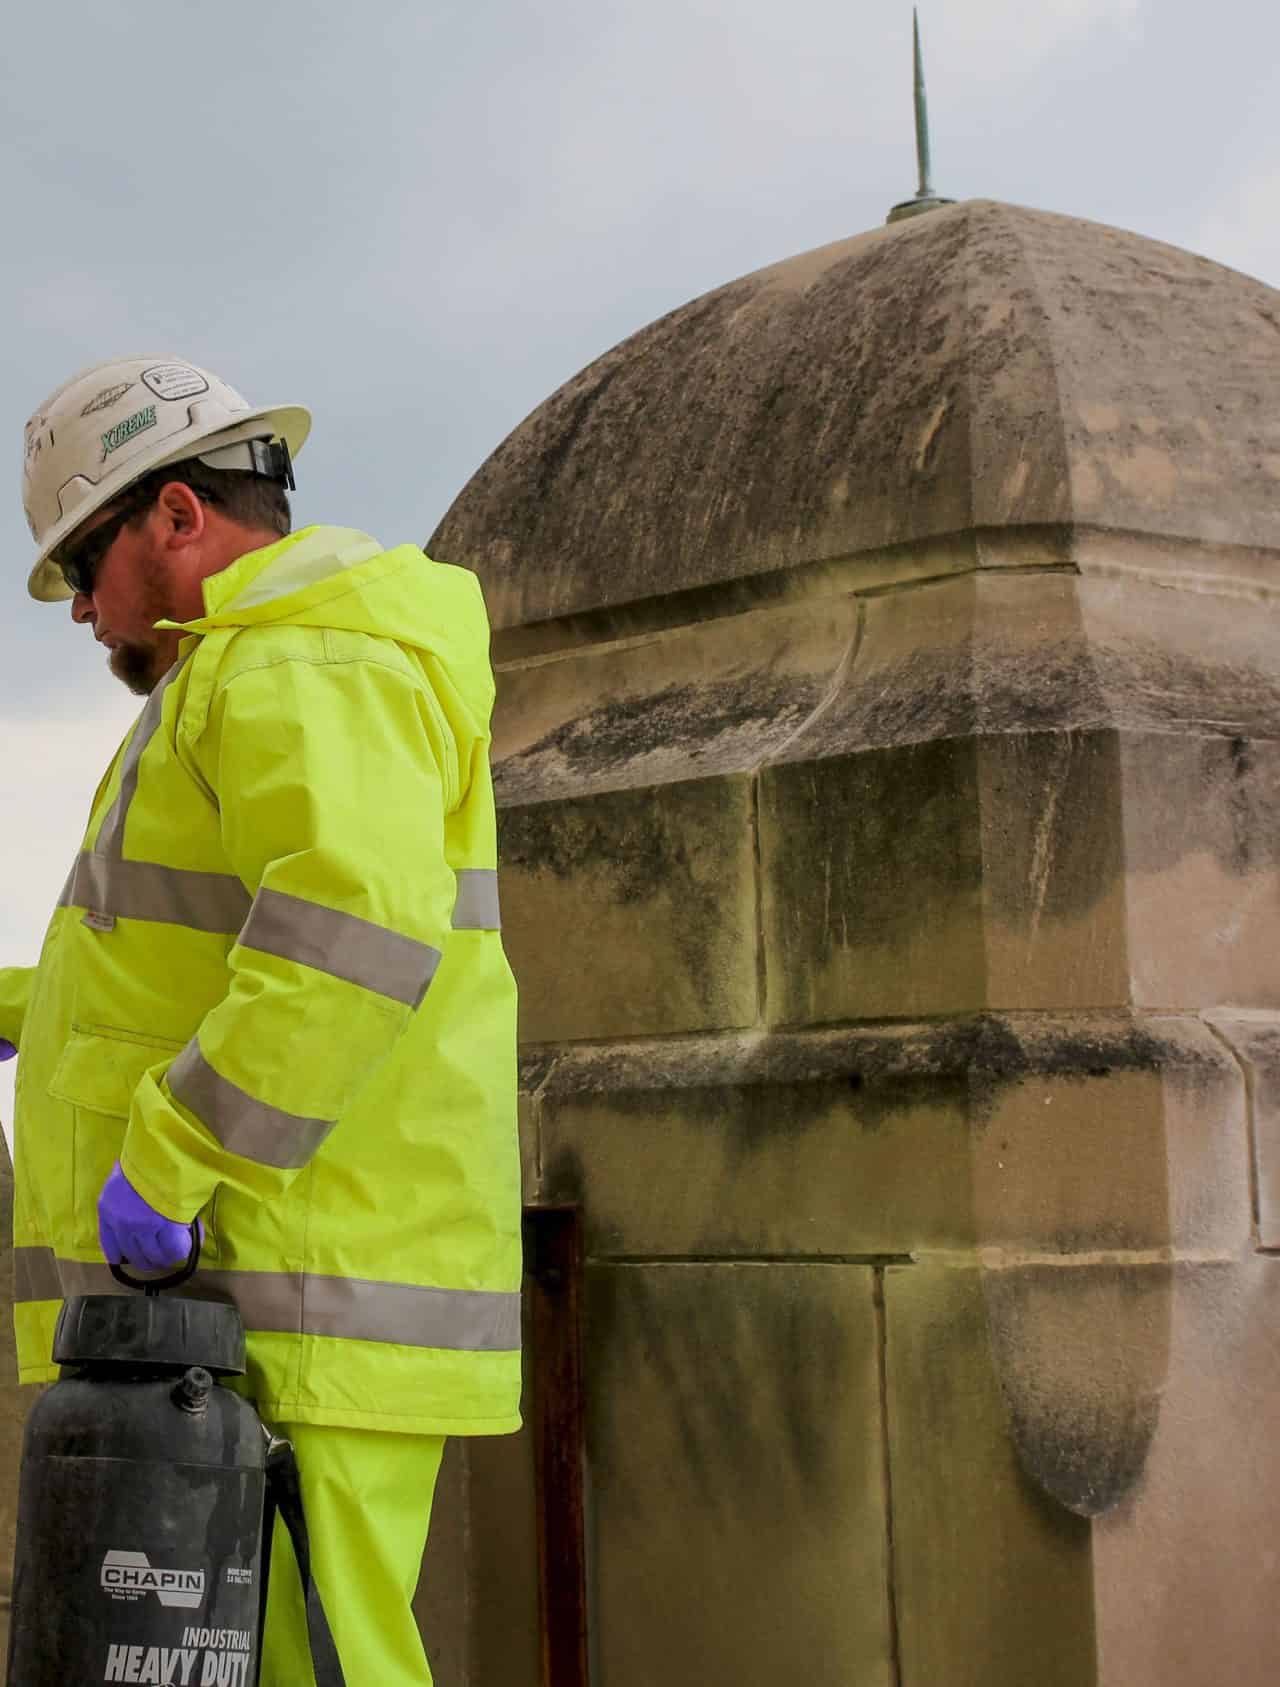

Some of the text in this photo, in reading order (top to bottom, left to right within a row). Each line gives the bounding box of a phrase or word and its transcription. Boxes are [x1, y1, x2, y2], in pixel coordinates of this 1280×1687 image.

[102, 405, 157, 454] XTREME
[104, 1569, 201, 1589] CHAPIN
[182, 1627, 251, 1650] INDUSTRIAL
[104, 1644, 251, 1687] HEAVY DUTY
